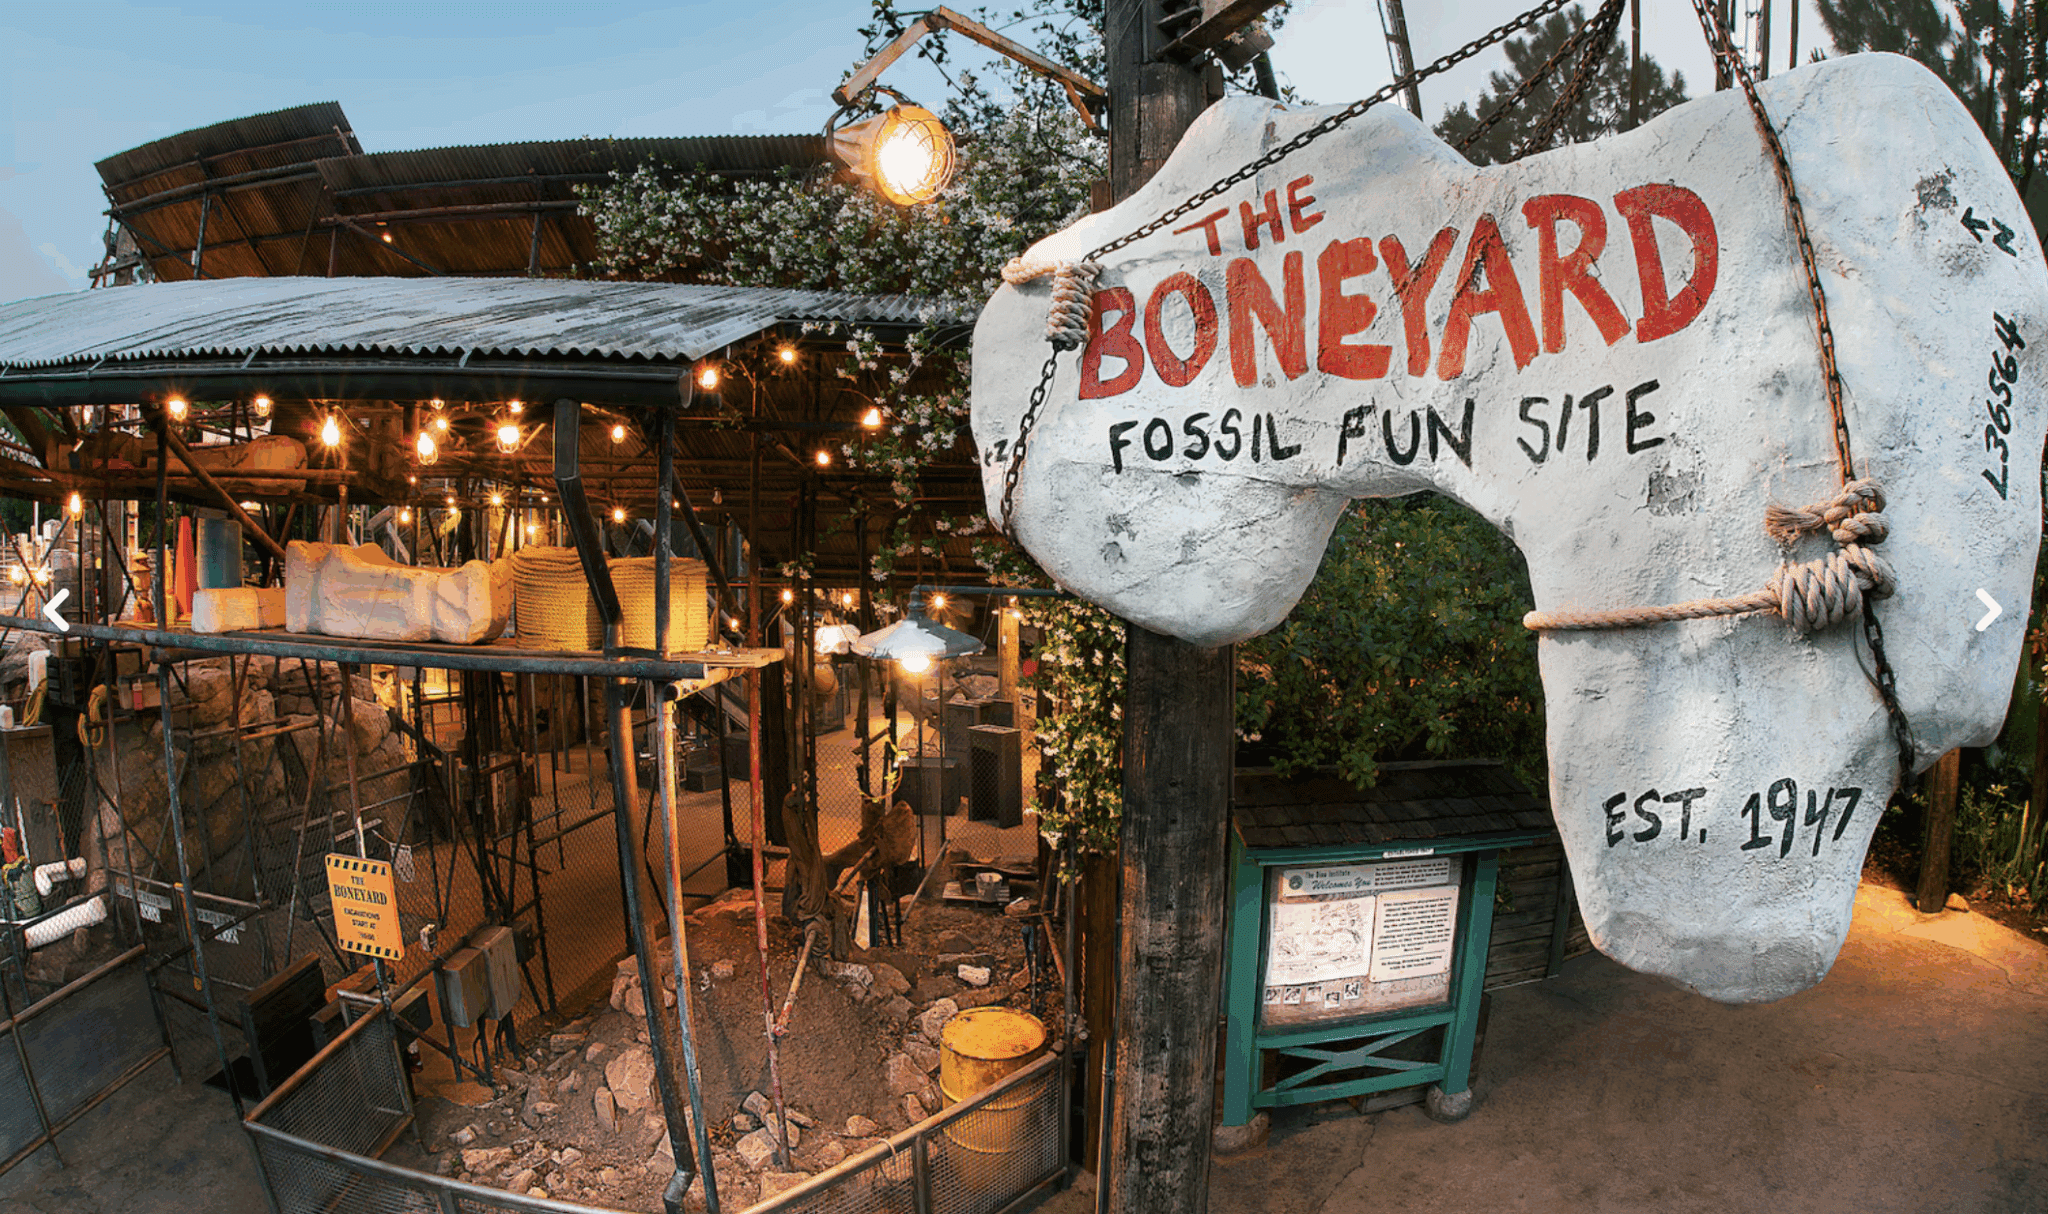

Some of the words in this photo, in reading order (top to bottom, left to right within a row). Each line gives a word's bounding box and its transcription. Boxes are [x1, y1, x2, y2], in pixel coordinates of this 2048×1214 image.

[1173, 174, 1326, 256] THE
[1078, 182, 1719, 400] BONEYARD
[1109, 408, 1303, 474] FOSSIL
[1335, 397, 1476, 472] FUN
[1515, 378, 1667, 465] SITE
[1601, 786, 1708, 848] EST.
[1740, 777, 1863, 859] 1947
[333, 884, 387, 906] BONEYARD
[350, 875, 364, 886] THE
[1354, 876, 1372, 889] You
